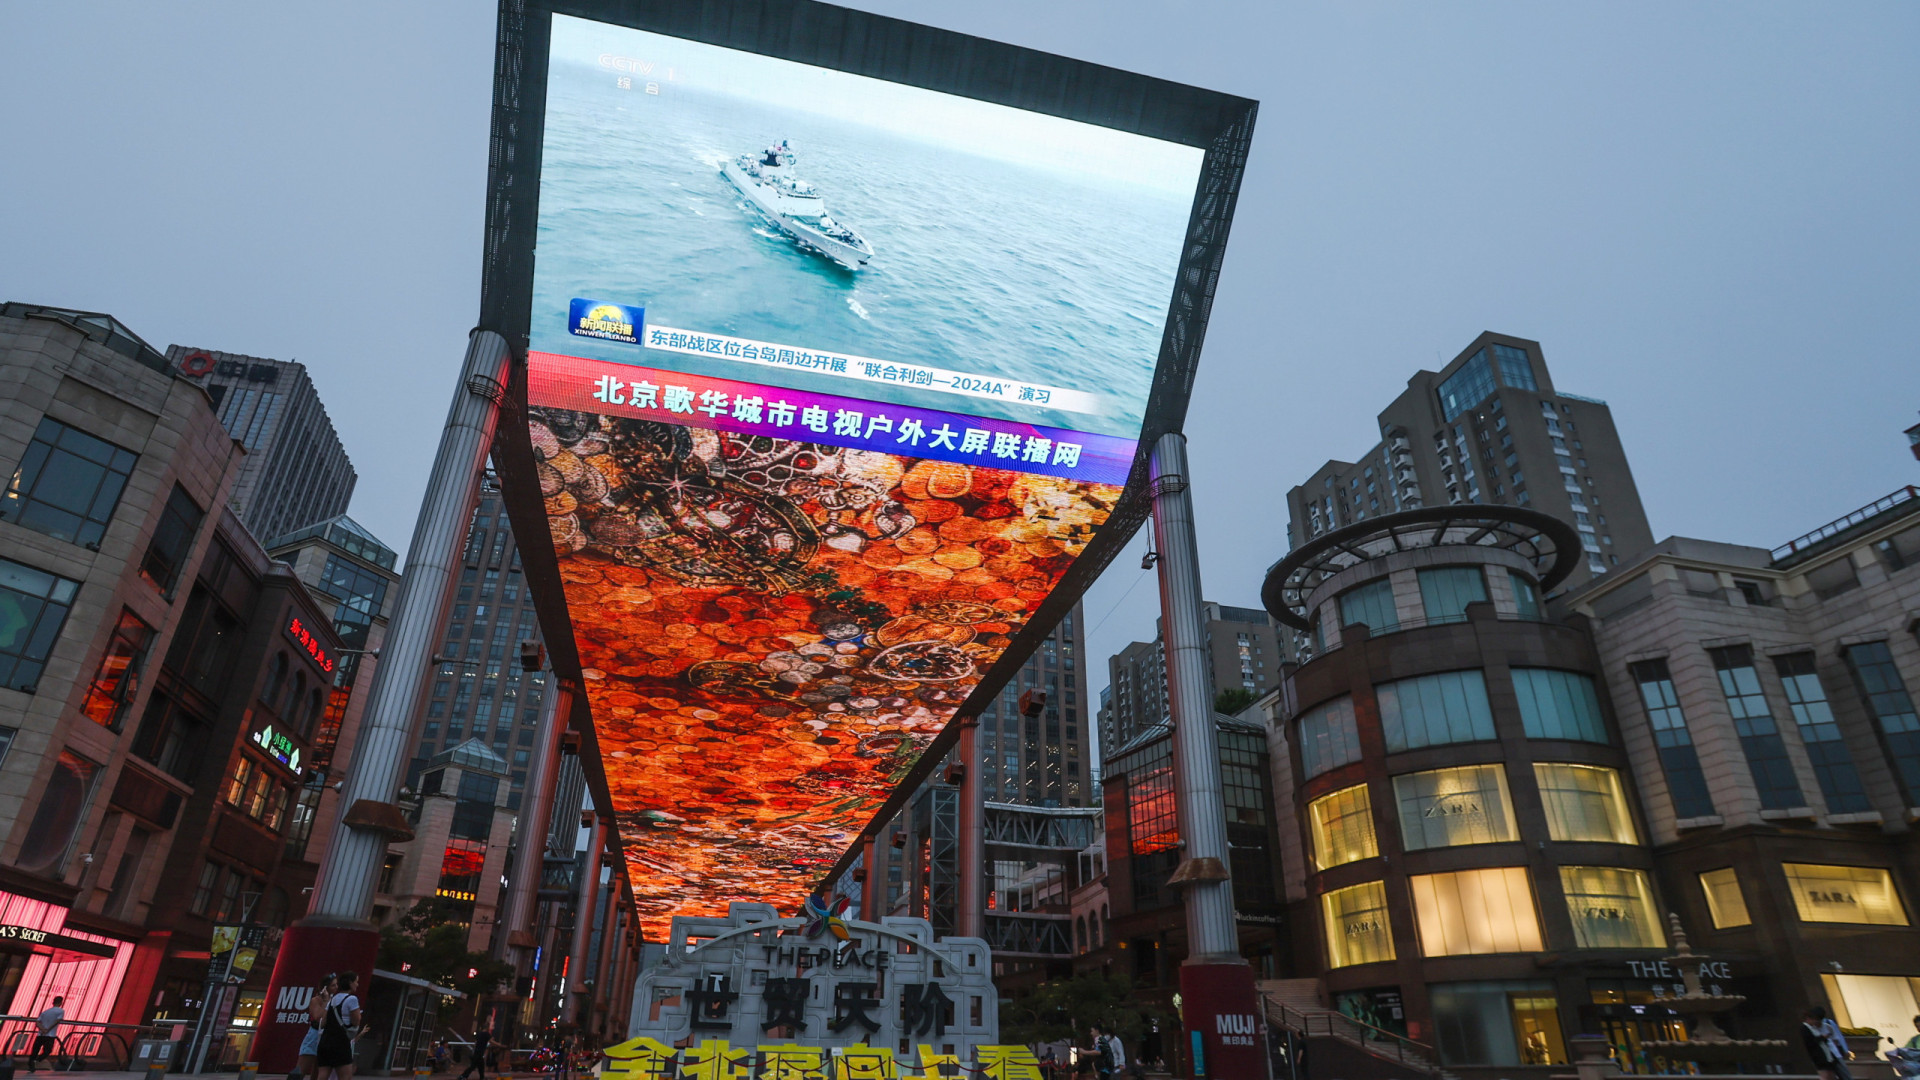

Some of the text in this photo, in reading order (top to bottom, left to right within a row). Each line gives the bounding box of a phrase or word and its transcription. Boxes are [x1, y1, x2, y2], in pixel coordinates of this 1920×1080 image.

[598, 53, 656, 76] CCTV
[617, 76, 659, 96] 综合
[579, 316, 634, 337] 新闻联播
[574, 328, 637, 344] XINWEN LIANBO
[592, 374, 1084, 469] 北京歌华城市电视户外大屏联播网
[1425, 803, 1479, 818] ZARA
[1809, 890, 1857, 904] ZARA
[19, 928, 47, 943] SECRET
[1346, 920, 1382, 936] ZARA
[762, 945, 889, 969] THE PLACE
[1626, 960, 1733, 978] THE ACE
[276, 986, 314, 1010] MU
[1652, 983, 1722, 999] 世贸阶
[685, 977, 954, 1036] 世贸天阶
[276, 1012, 310, 1024] 無印良
[1216, 1014, 1256, 1035] MUJI
[1222, 1036, 1255, 1047] 無印良品
